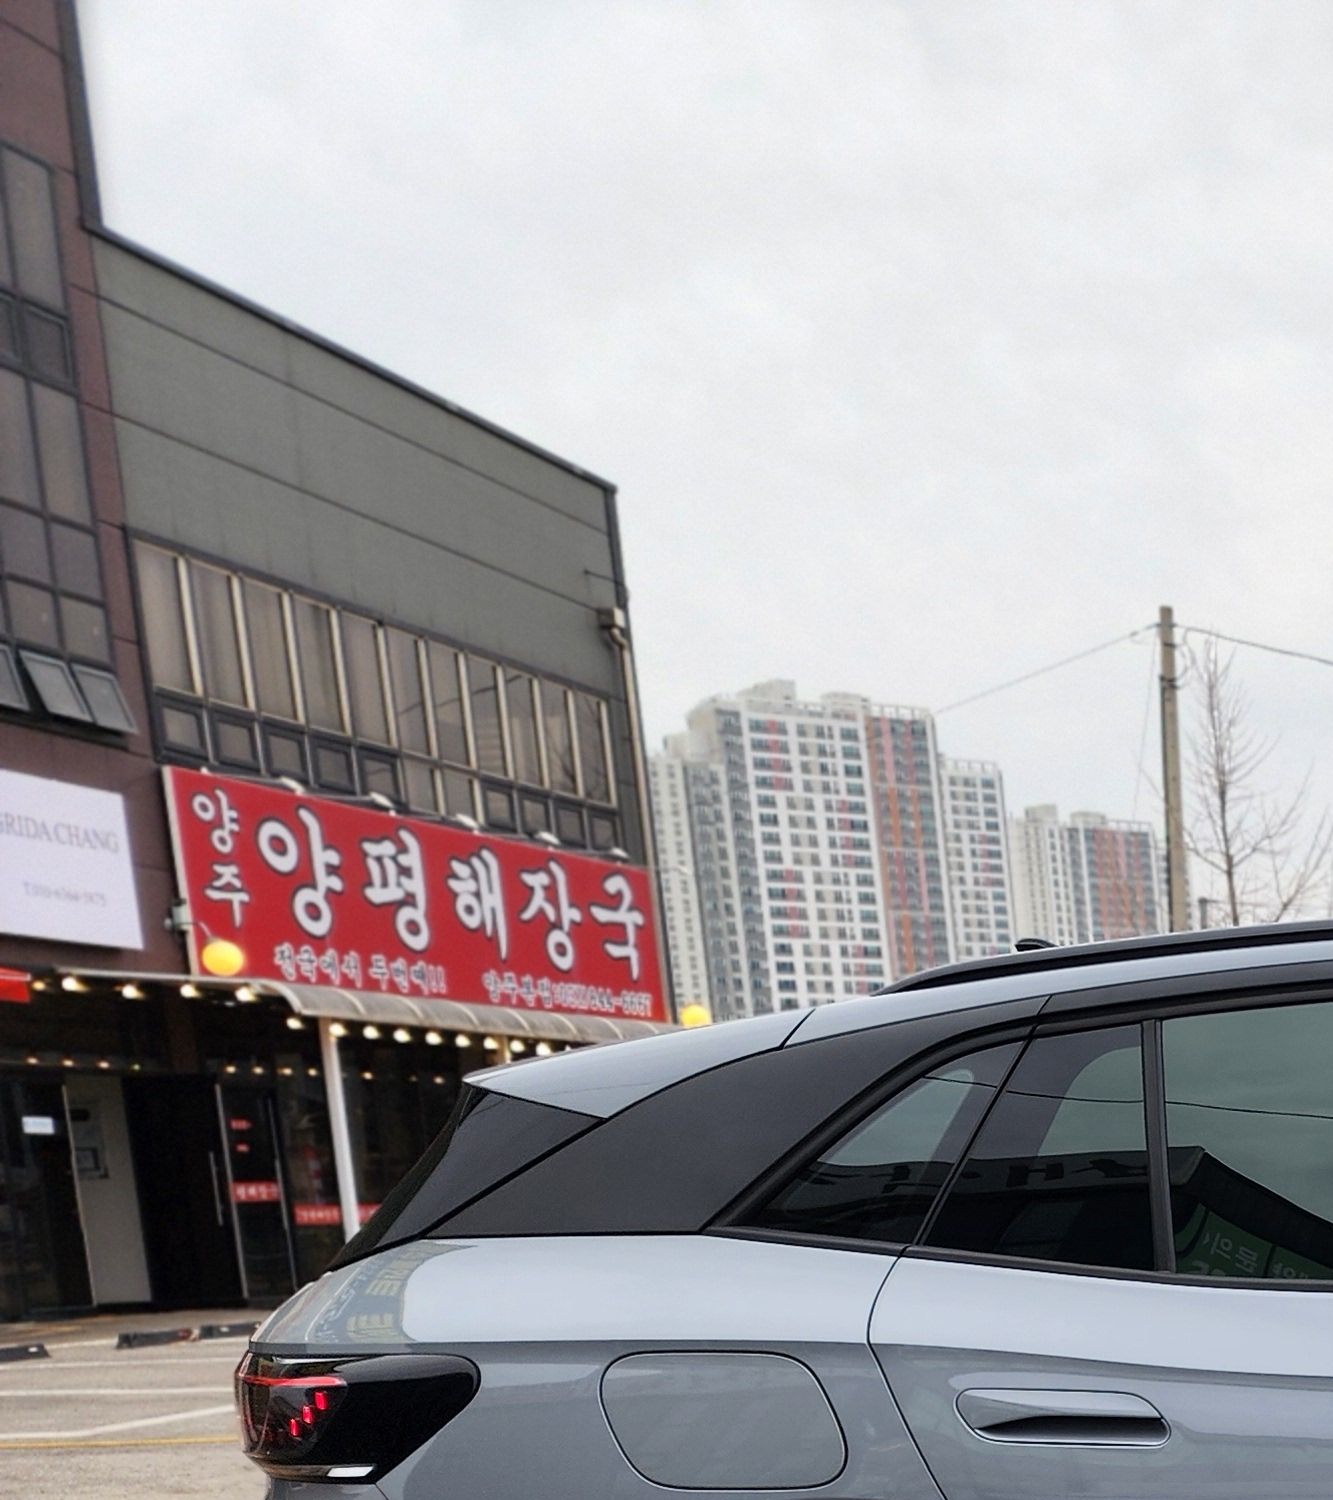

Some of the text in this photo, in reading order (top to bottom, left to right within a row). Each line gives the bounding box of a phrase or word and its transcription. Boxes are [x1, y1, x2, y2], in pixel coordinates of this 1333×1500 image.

[54, 822, 120, 854] CHANG
[192, 789, 250, 928] 양주
[257, 807, 645, 982] 양평해장국
[274, 942, 362, 989] 전국에서
